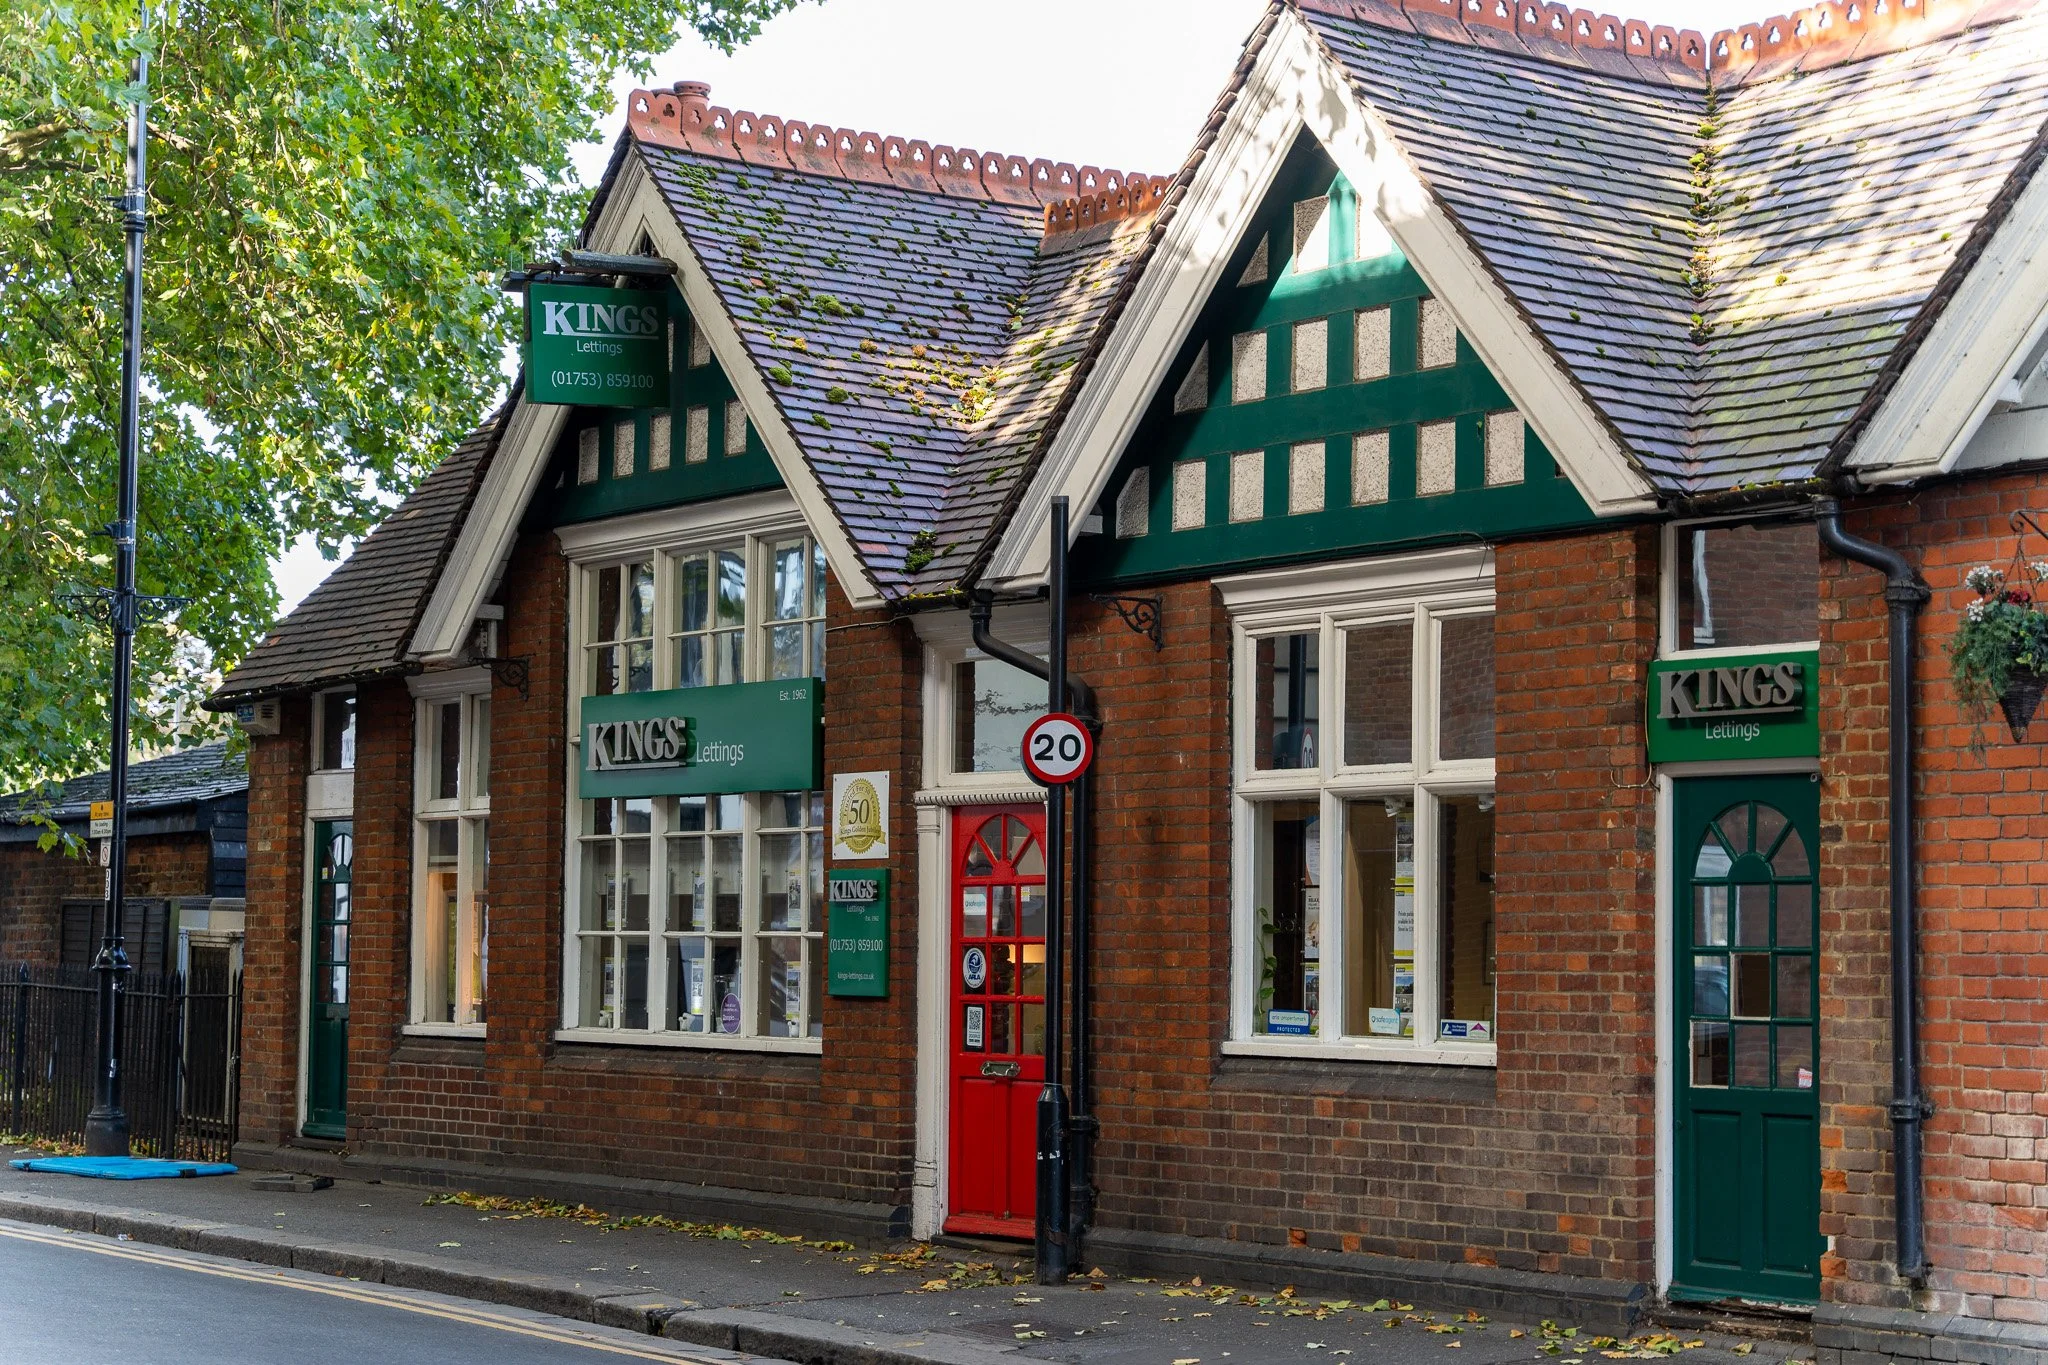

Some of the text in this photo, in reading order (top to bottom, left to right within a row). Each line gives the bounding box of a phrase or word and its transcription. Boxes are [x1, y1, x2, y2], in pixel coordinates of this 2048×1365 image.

[542, 301, 660, 339] KINGS
[576, 340, 623, 356] Lettings
[551, 370, 654, 389] (01753) 859100
[779, 688, 807, 701] Est. 1962
[1656, 661, 1800, 719] KINGS
[1705, 720, 1760, 741] Lettings
[586, 715, 685, 771] KINGS
[696, 740, 744, 766] Lettings
[1034, 733, 1082, 762] 20
[848, 798, 870, 825] 50
[851, 826, 866, 834] Golden
[829, 879, 876, 902] KINGS
[846, 905, 865, 915] Lettings
[830, 938, 884, 954] (01753) 859100
